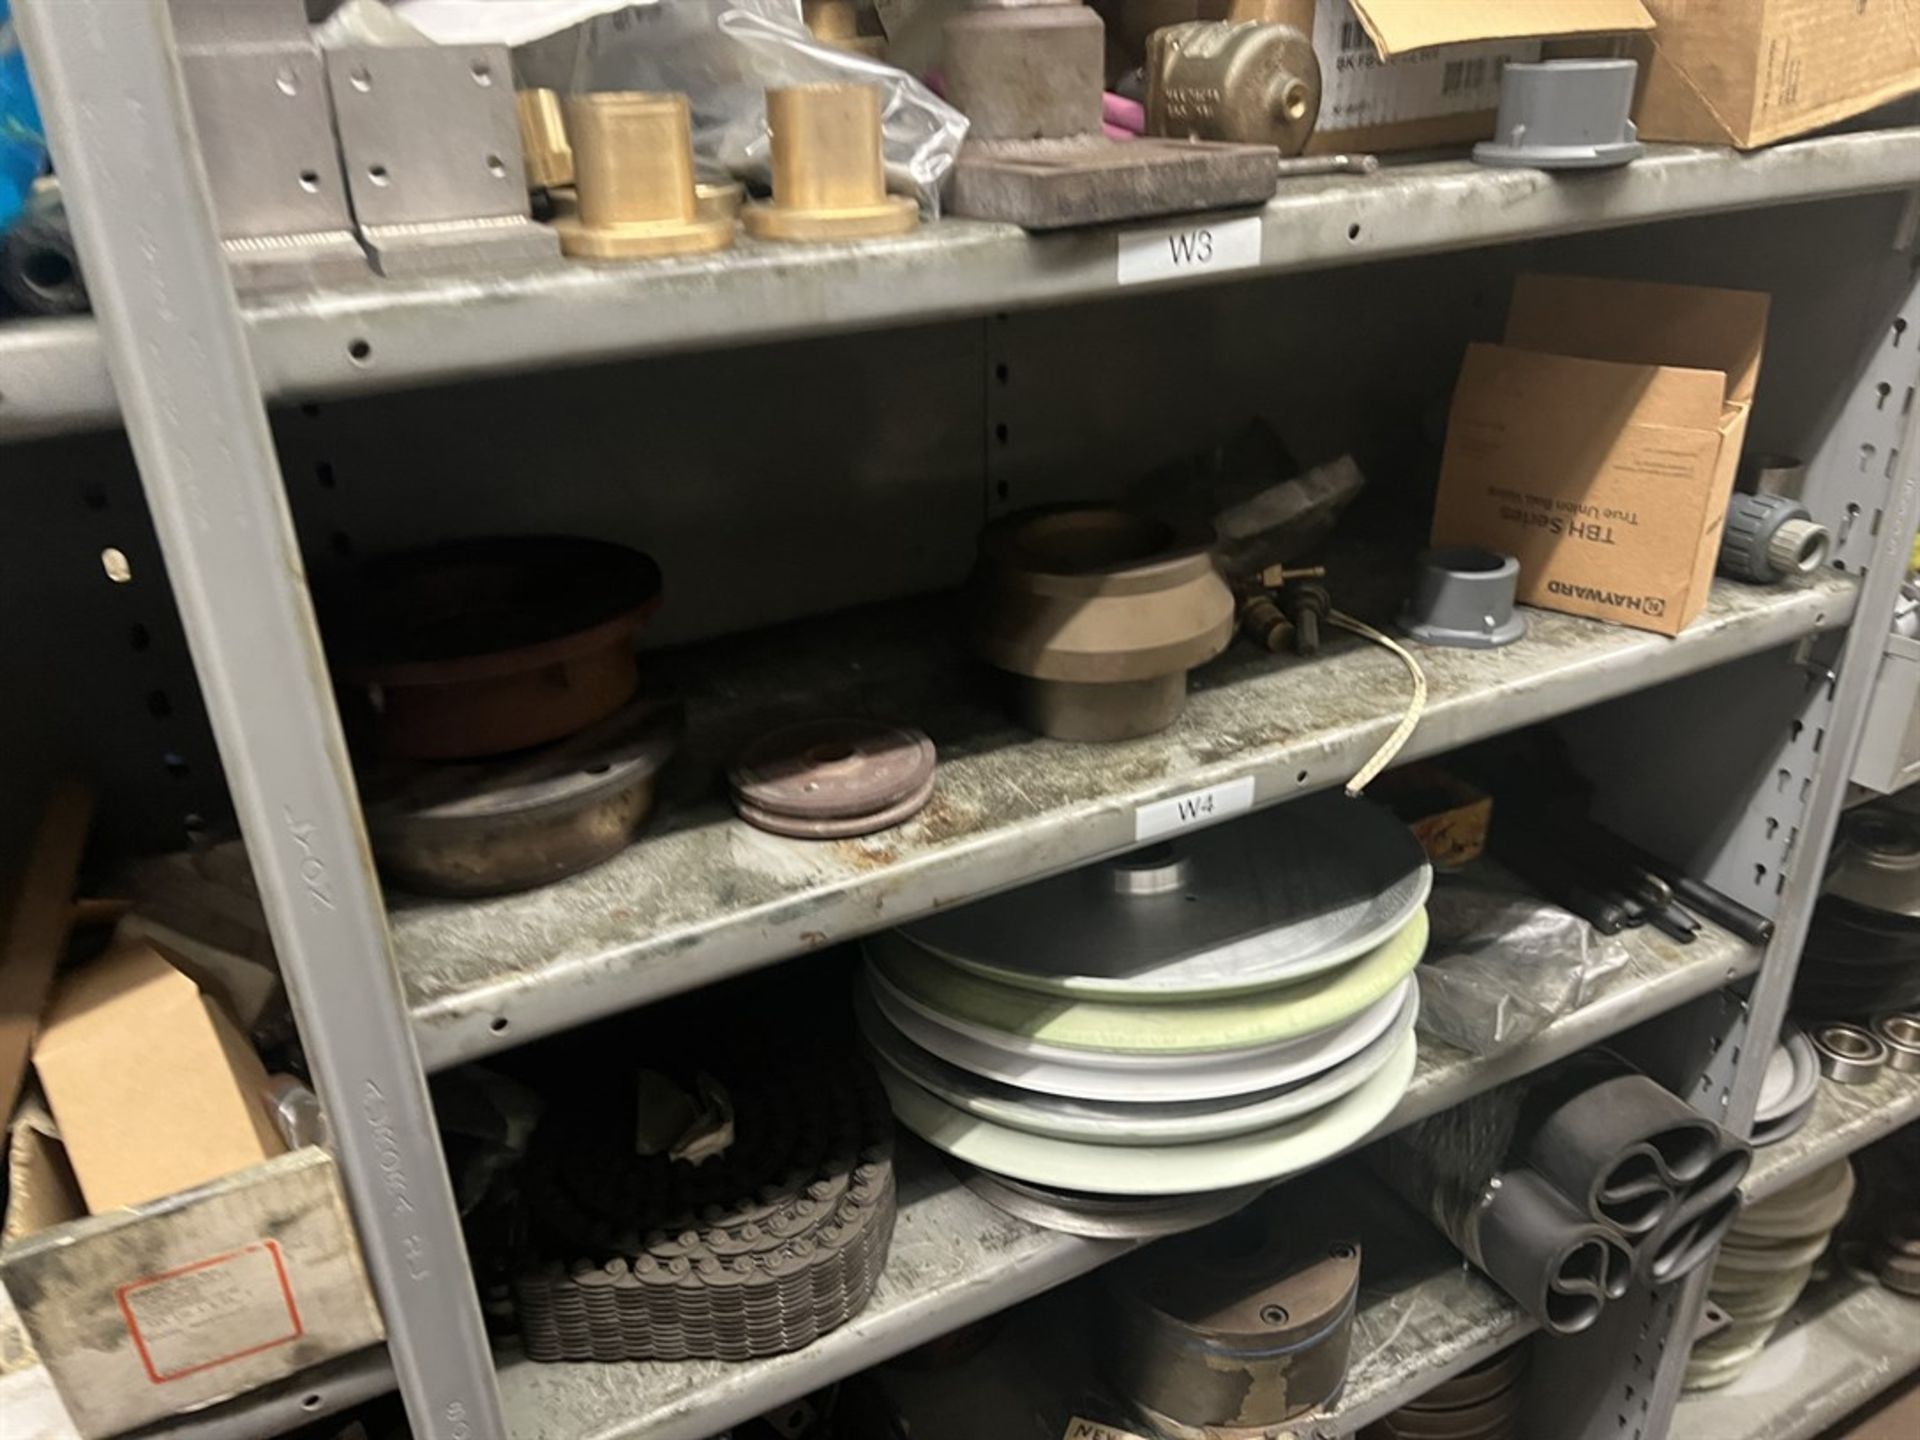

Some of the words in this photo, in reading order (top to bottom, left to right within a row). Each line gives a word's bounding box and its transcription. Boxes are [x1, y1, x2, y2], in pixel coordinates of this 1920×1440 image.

[1168, 229, 1213, 265] W3
[1499, 505, 1563, 535] Series
[1556, 499, 1600, 520] Union
[1603, 508, 1640, 526] True
[1568, 519, 1616, 546] TBH
[1546, 579, 1642, 611] HAYWARD
[1177, 793, 1215, 821] W4
